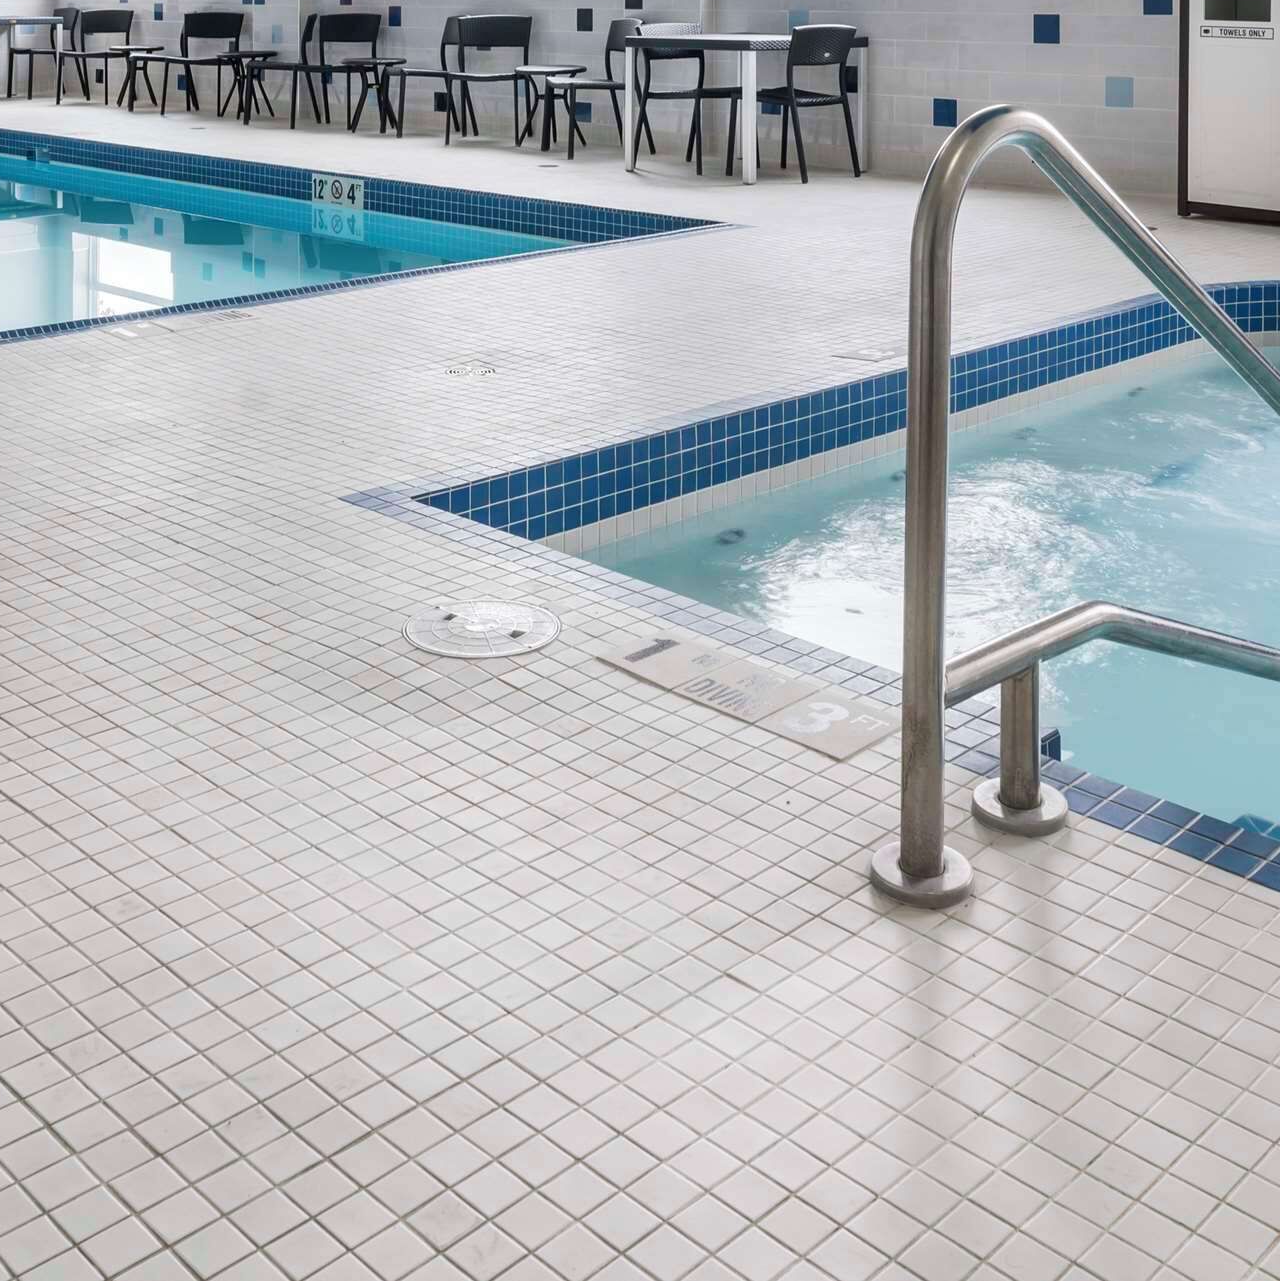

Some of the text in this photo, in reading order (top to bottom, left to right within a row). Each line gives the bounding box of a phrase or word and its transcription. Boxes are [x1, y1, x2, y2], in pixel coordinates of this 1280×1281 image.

[1219, 28, 1266, 37] TOWELS ONLY
[347, 183, 356, 205] 4
[684, 677, 756, 716] DIVIN
[783, 702, 851, 734] 3
[849, 714, 890, 732] FT
